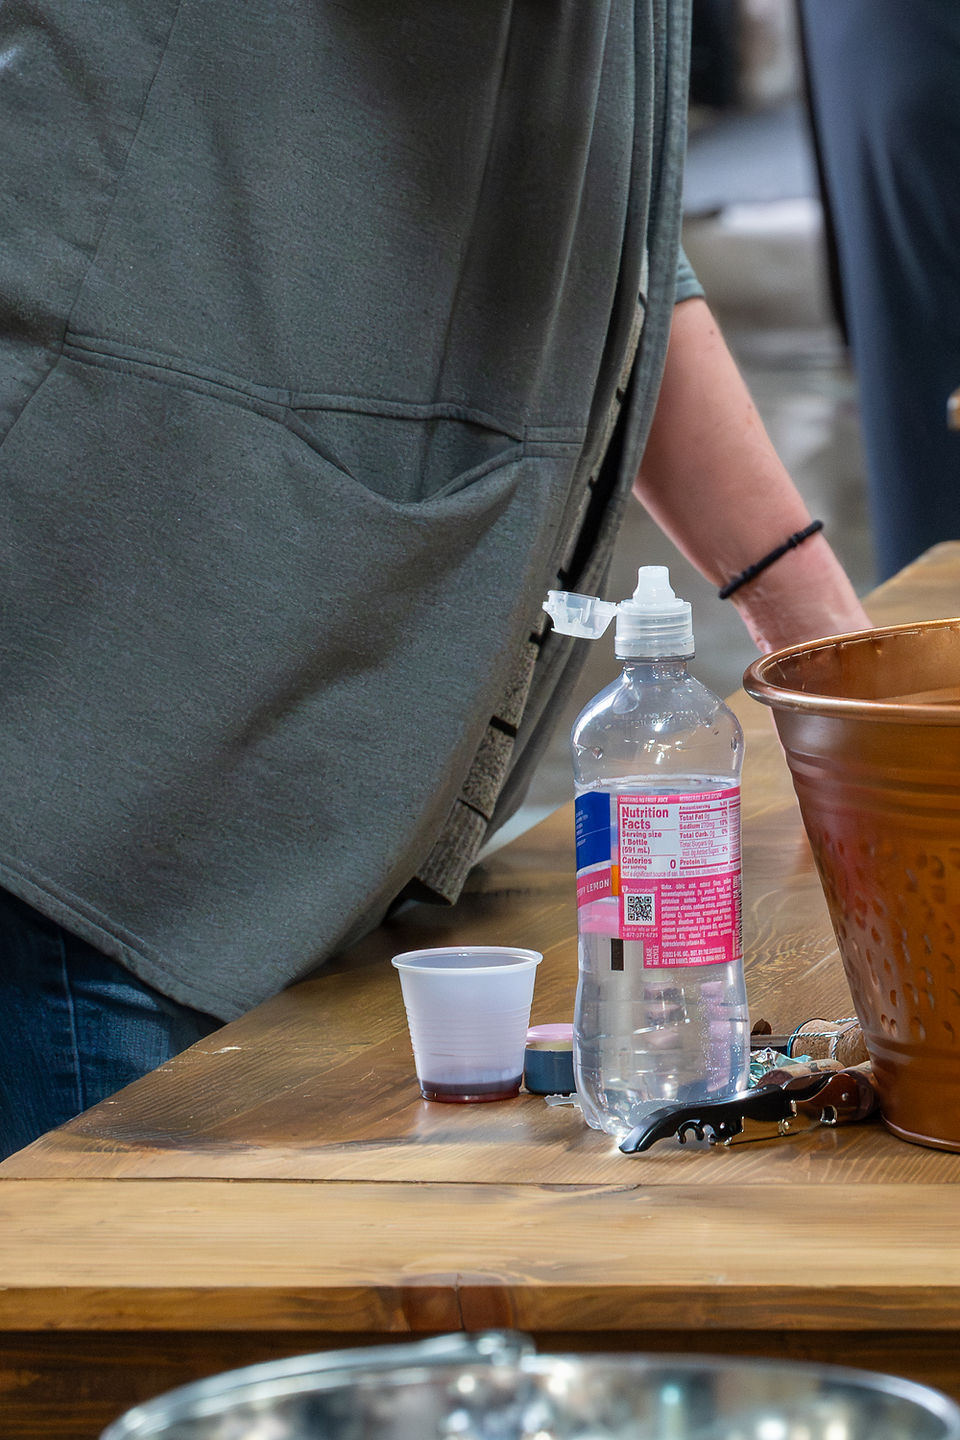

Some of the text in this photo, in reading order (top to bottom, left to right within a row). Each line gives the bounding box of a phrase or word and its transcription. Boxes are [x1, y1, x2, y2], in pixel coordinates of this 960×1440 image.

[622, 806, 669, 818] Nutrition
[680, 813, 694, 821] Total
[695, 812, 704, 820] Fat
[622, 818, 651, 829] Facts
[622, 830, 662, 839] Serving size
[628, 838, 648, 846] Bottle
[637, 846, 650, 855] mL)
[622, 856, 652, 865] Calories
[669, 859, 677, 870] 0
[680, 858, 700, 866] Protein
[586, 878, 610, 893] LEMON
